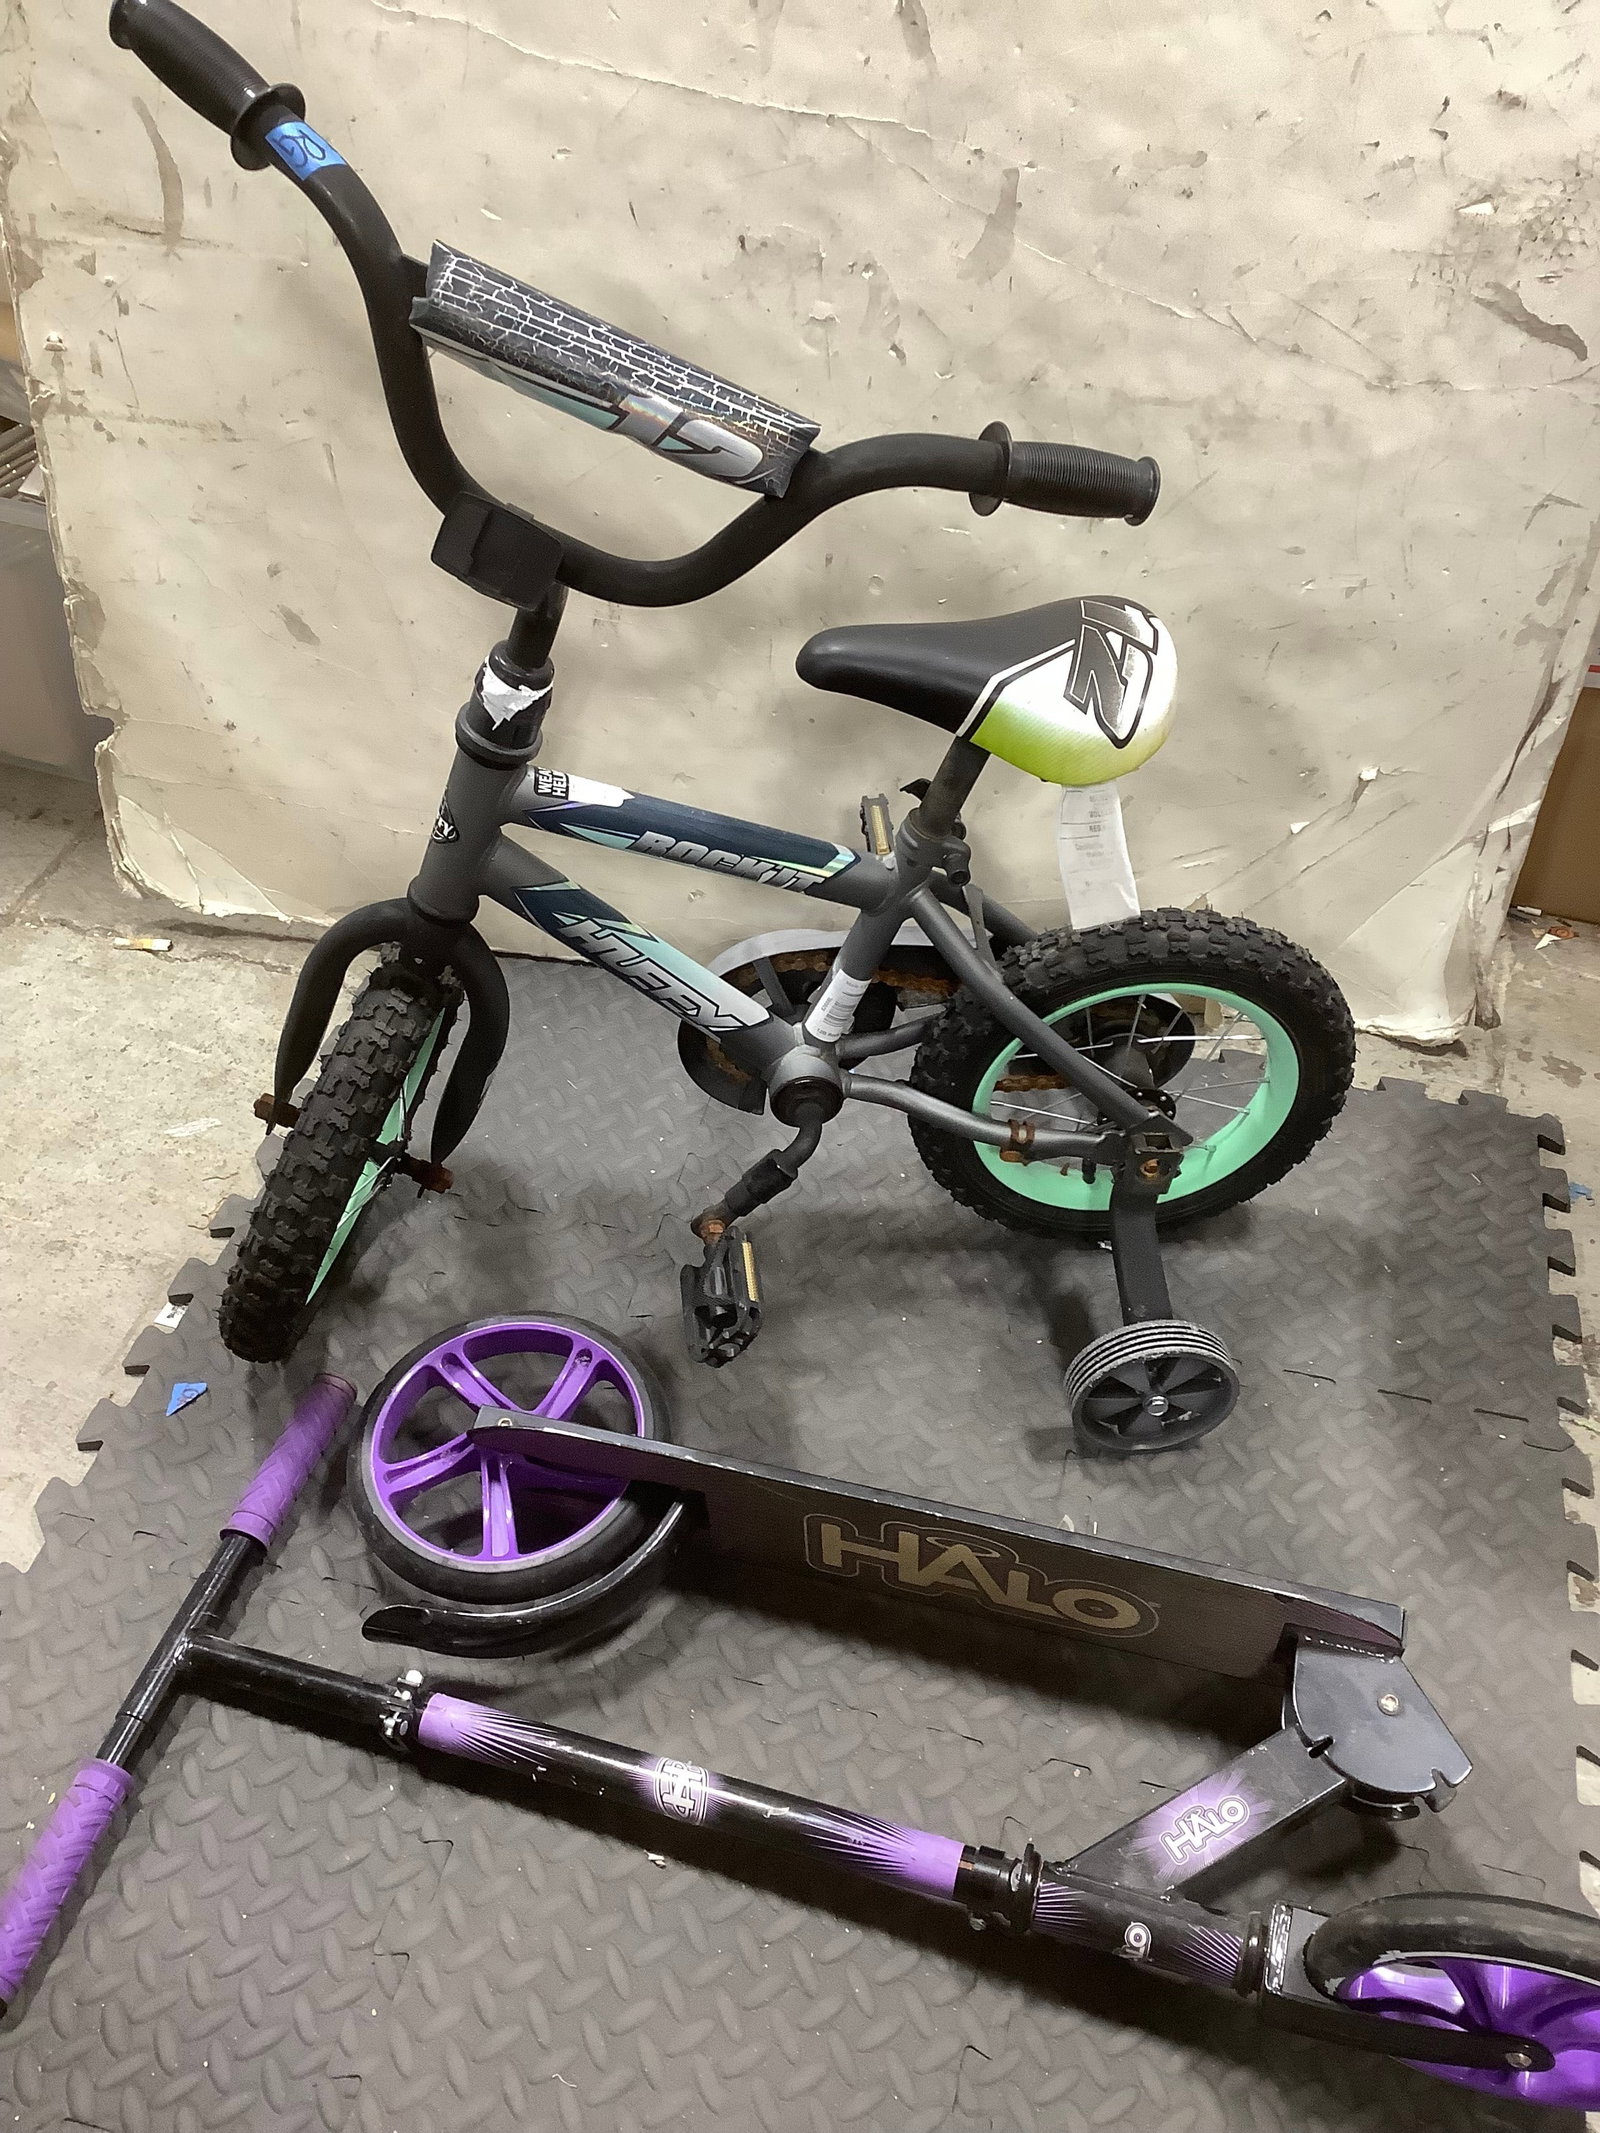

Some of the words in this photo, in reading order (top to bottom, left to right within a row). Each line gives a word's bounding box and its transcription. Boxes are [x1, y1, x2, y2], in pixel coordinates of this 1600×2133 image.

[537, 766, 553, 794] WEA
[551, 769, 567, 798] HEL
[556, 918, 746, 1031] HUFFY
[820, 1522, 1141, 1629] HALO
[1164, 1799, 1246, 1860] HALO
